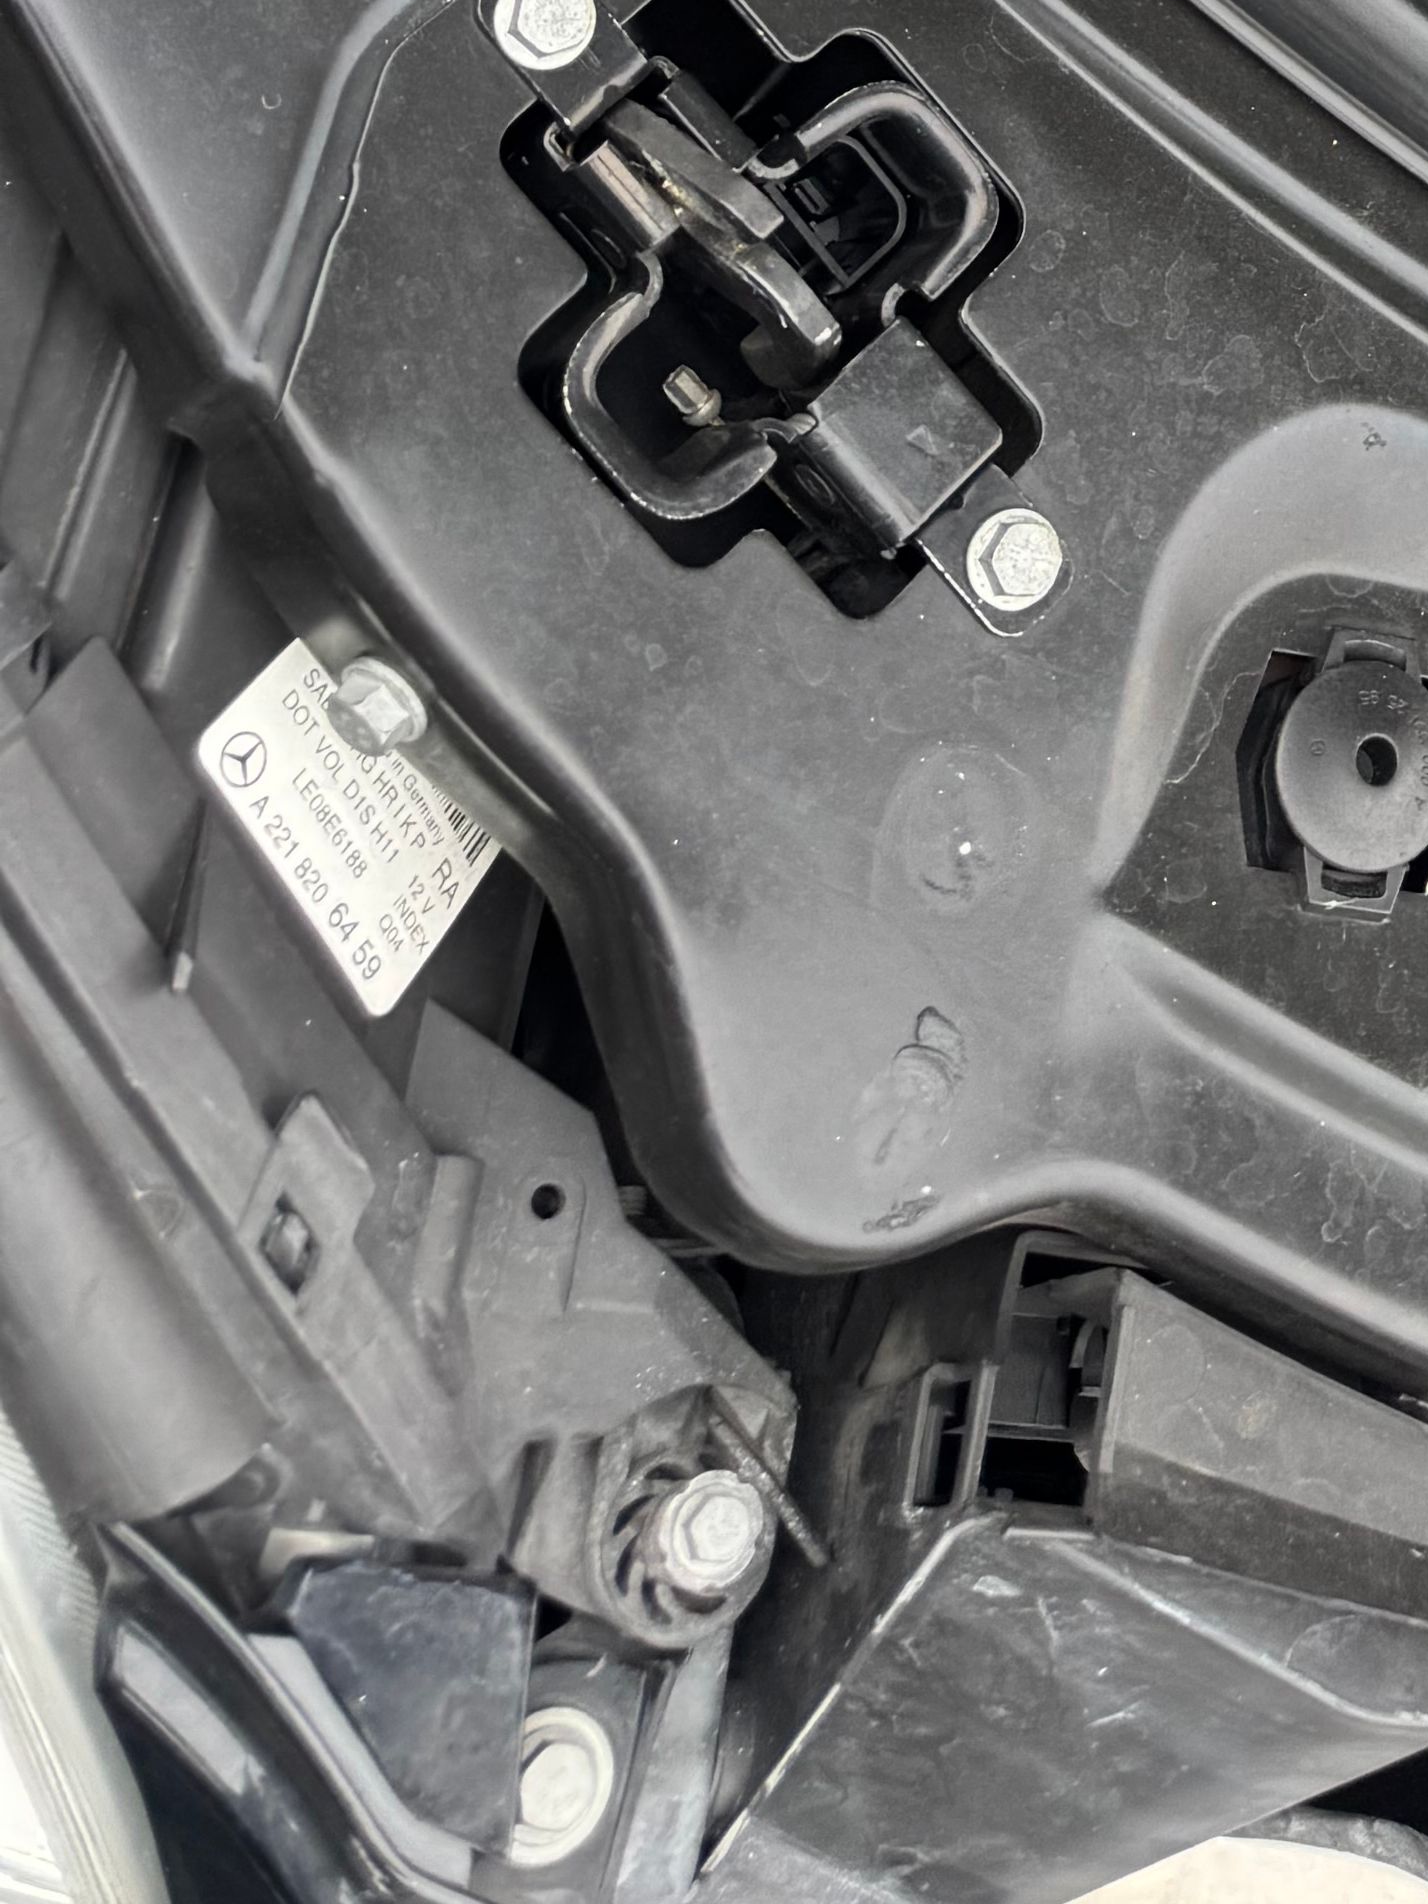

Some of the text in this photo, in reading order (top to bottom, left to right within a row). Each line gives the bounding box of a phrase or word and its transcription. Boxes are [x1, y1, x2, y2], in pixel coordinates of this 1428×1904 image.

[281, 688, 320, 736] DOT
[315, 735, 346, 784] VOL
[371, 821, 400, 863] H11
[403, 774, 445, 846] Germany
[410, 833, 426, 849] P
[249, 796, 382, 981] A 221 820 64 59
[408, 875, 436, 915] 12 V
[431, 857, 460, 909] RA
[393, 894, 430, 954] INDEX
